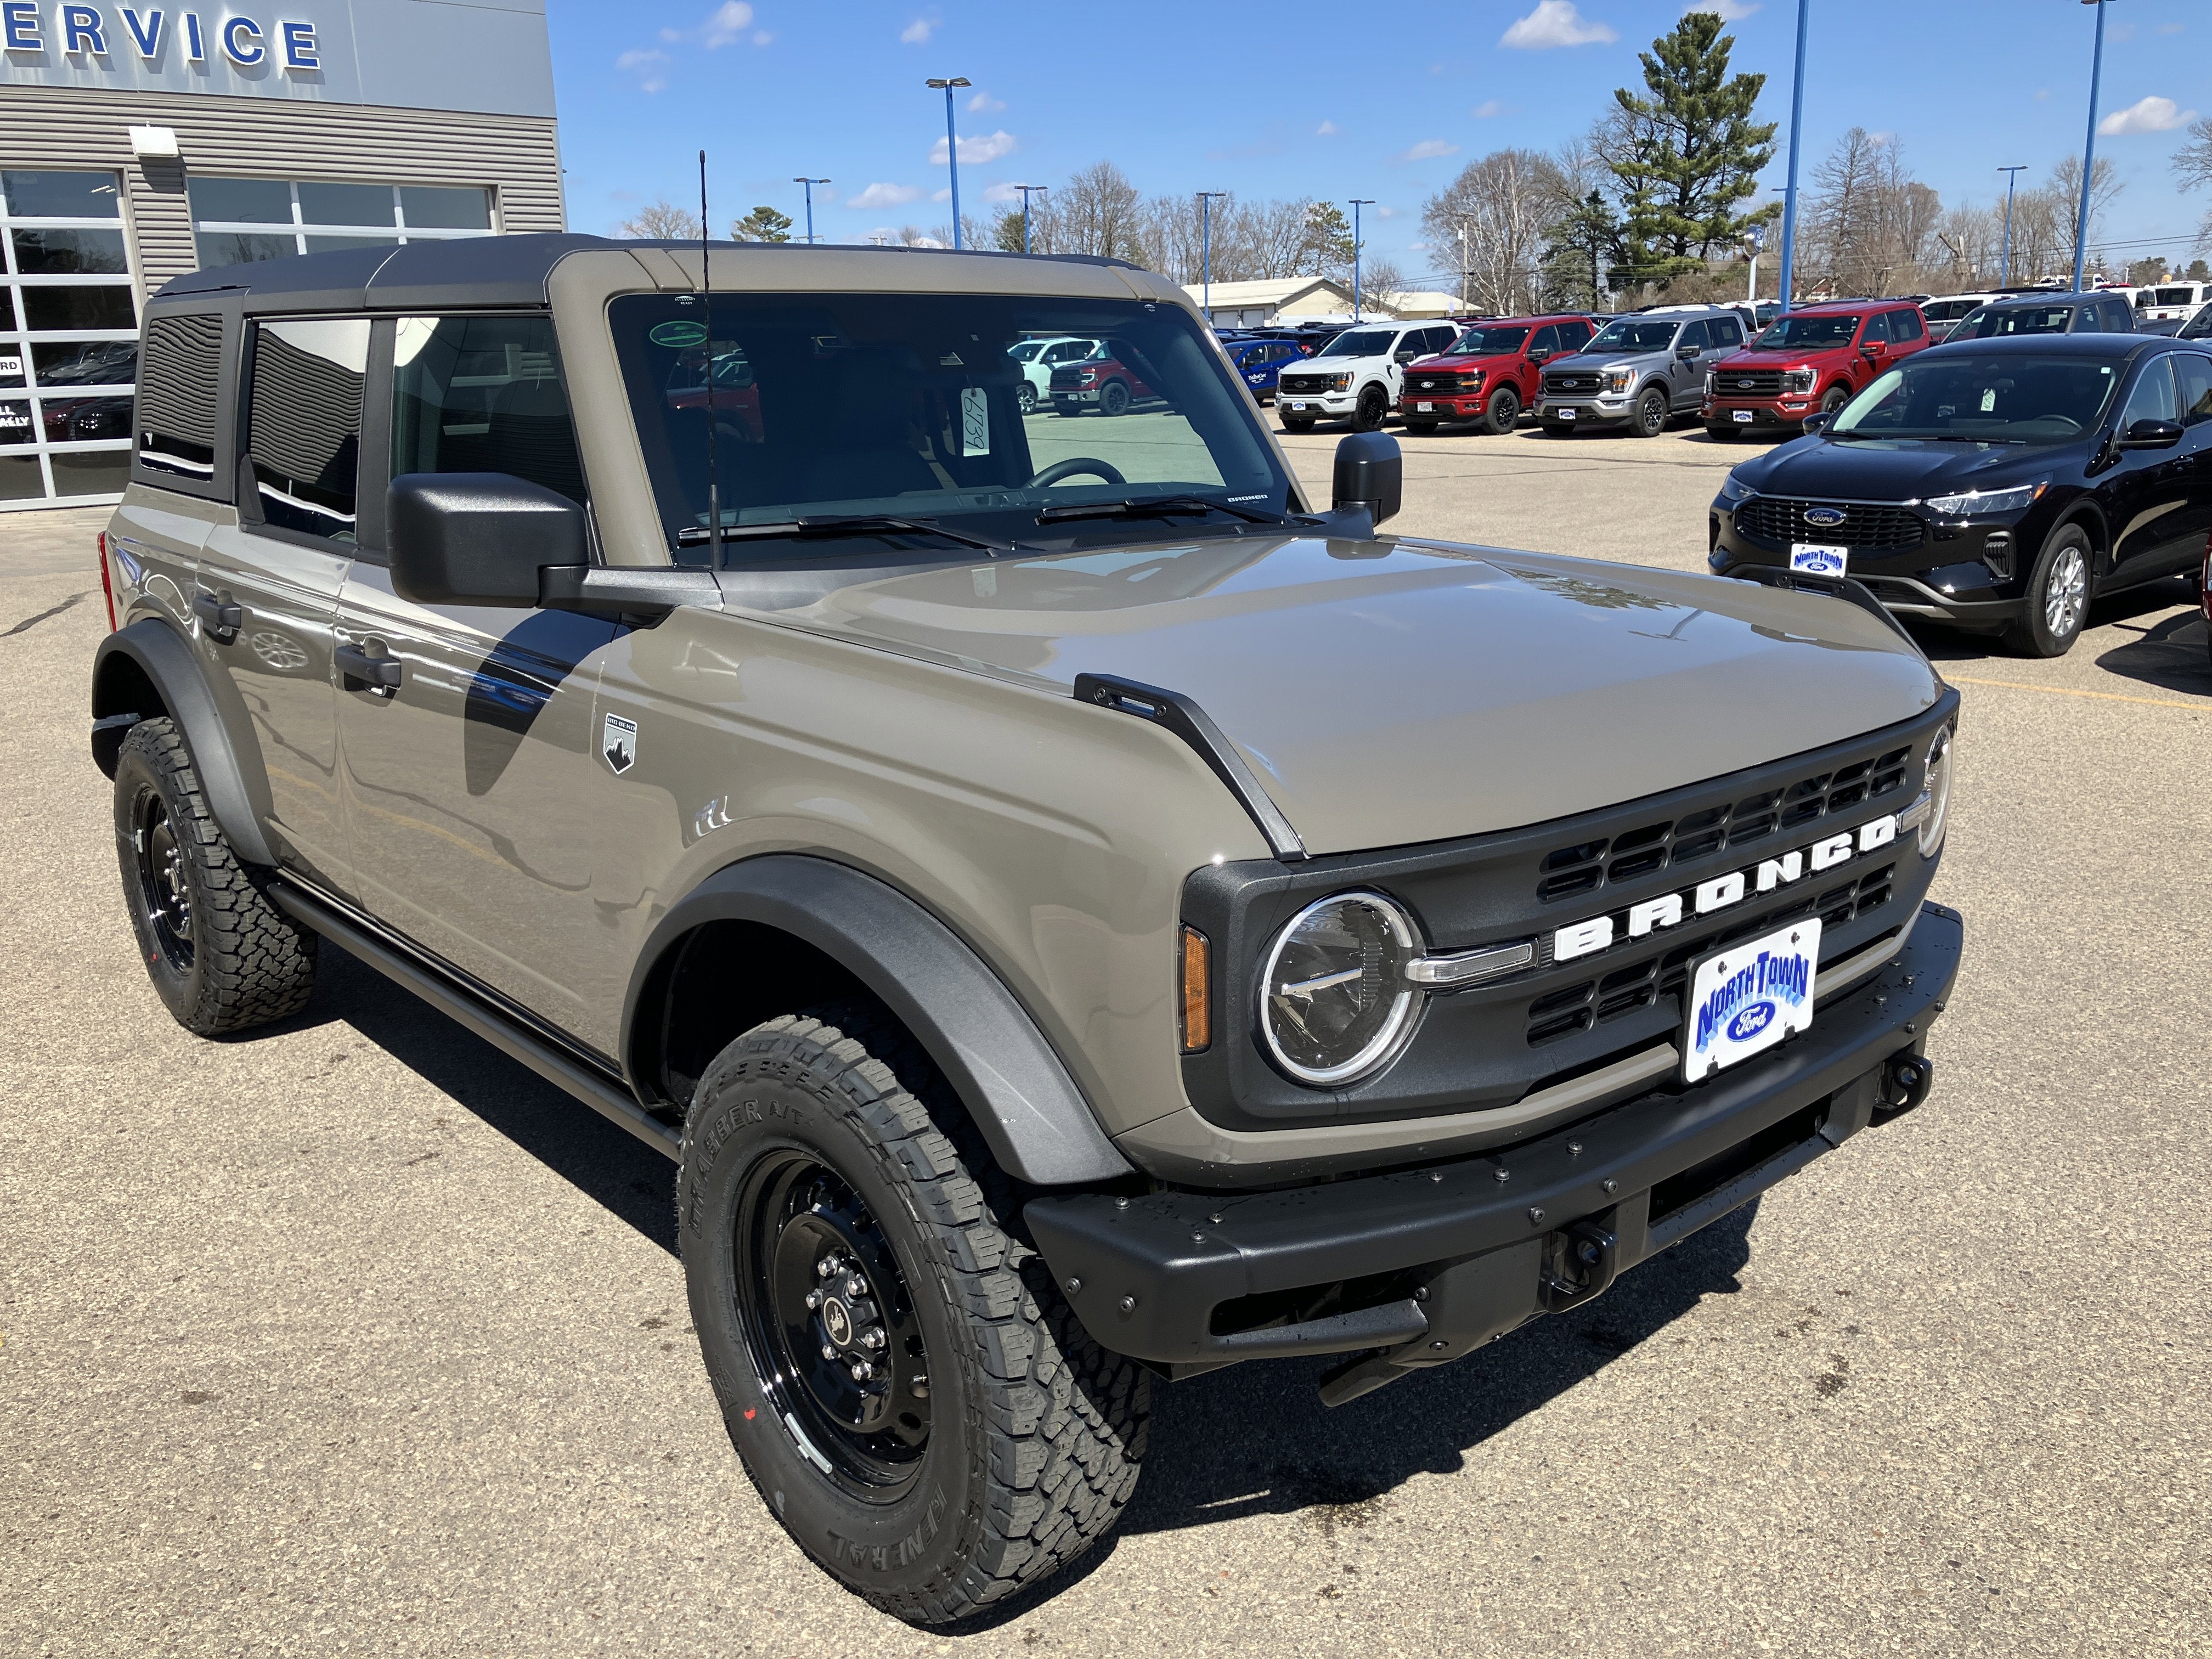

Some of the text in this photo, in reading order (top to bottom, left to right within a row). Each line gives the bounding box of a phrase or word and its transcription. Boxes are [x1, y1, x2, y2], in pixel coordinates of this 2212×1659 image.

[964, 397, 985, 449] 6739
[1812, 511, 1836, 522] Ford
[618, 721, 635, 731] BEND
[1554, 815, 1896, 962] BRONCO
[1736, 1006, 1768, 1036] Ford
[688, 1098, 762, 1239] GRABBER
[827, 1482, 948, 1572] GENERAL
